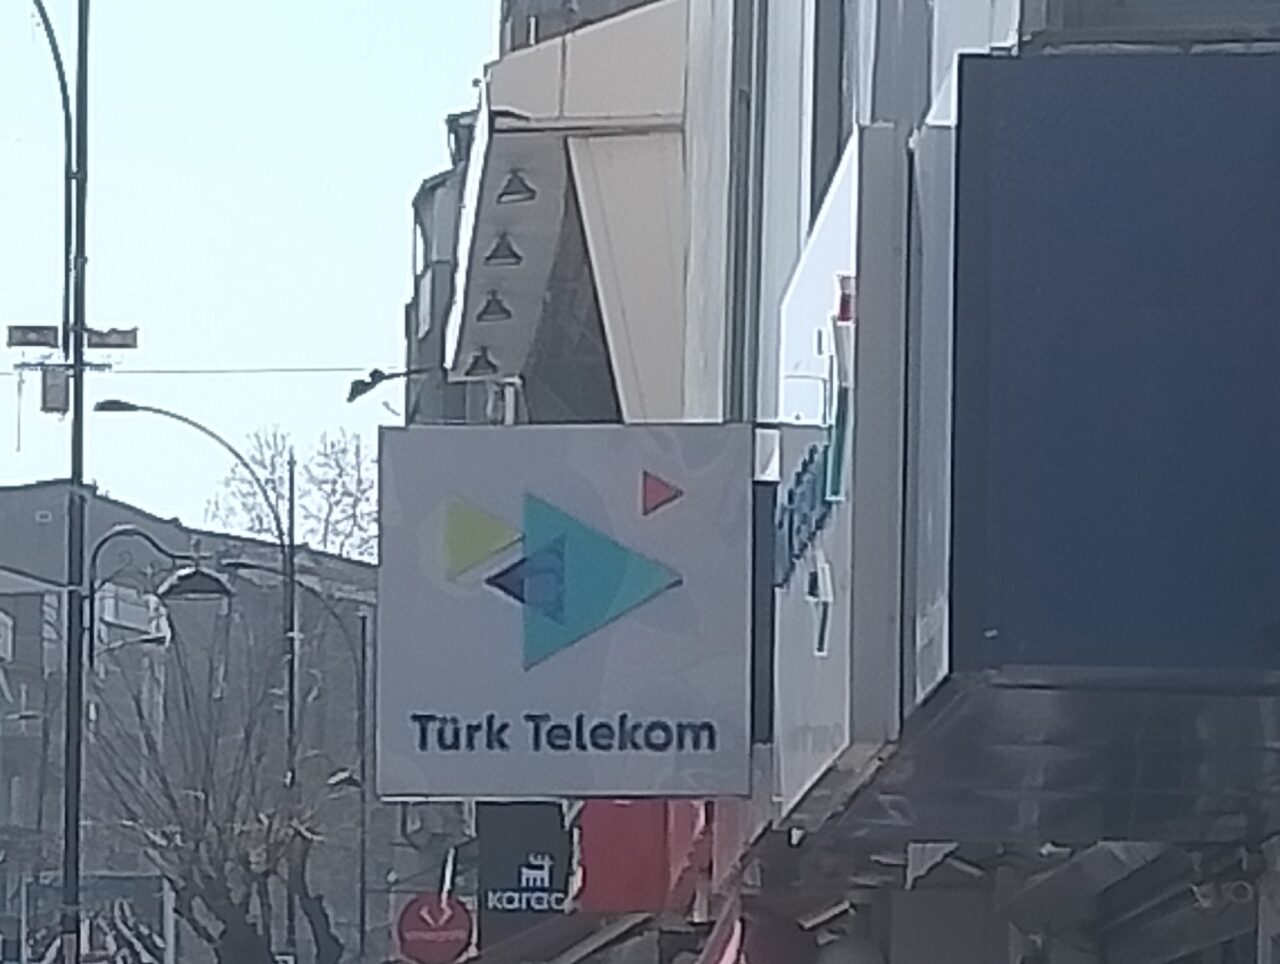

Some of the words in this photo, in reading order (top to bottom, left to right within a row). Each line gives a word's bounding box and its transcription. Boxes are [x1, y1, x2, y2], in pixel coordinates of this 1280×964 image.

[410, 712, 510, 751] Türk
[523, 712, 717, 751] Telekom
[487, 890, 568, 911] karac
